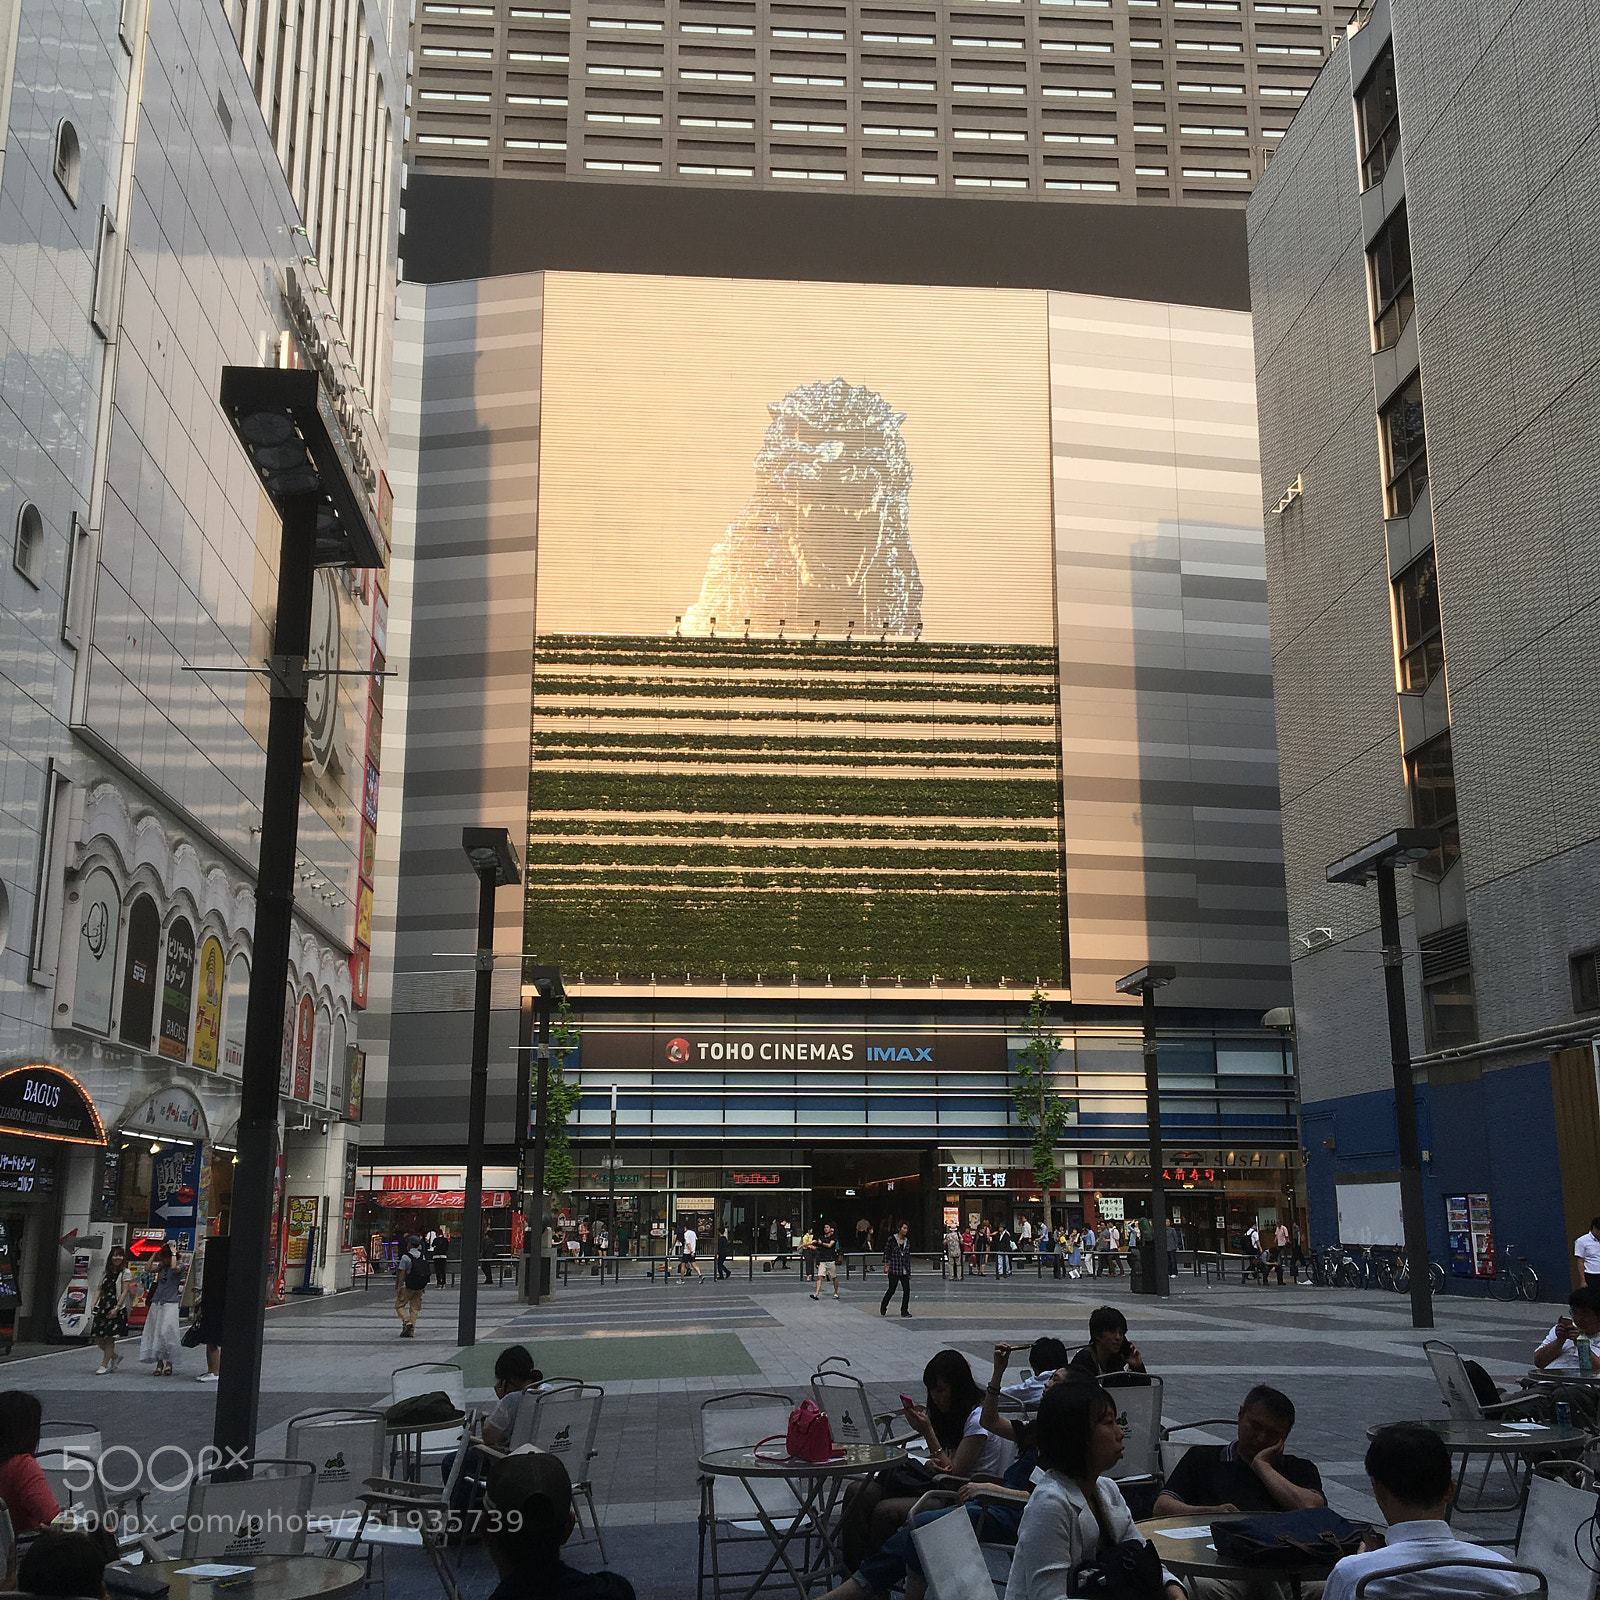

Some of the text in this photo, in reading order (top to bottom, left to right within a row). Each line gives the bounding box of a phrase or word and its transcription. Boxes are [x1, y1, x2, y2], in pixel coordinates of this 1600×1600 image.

[196, 1005, 217, 1038] ゲーム
[166, 1019, 186, 1041] BAGUS
[697, 1042, 854, 1061] TOHO CINEMAS
[866, 1047, 933, 1062] IMAX
[23, 1080, 60, 1107] BAGUS
[1093, 1154, 1268, 1167] ITAMA SUSHI
[382, 1175, 438, 1189] MARUHAN
[947, 1173, 1006, 1187] 大阪王将
[291, 1199, 316, 1212] まんが
